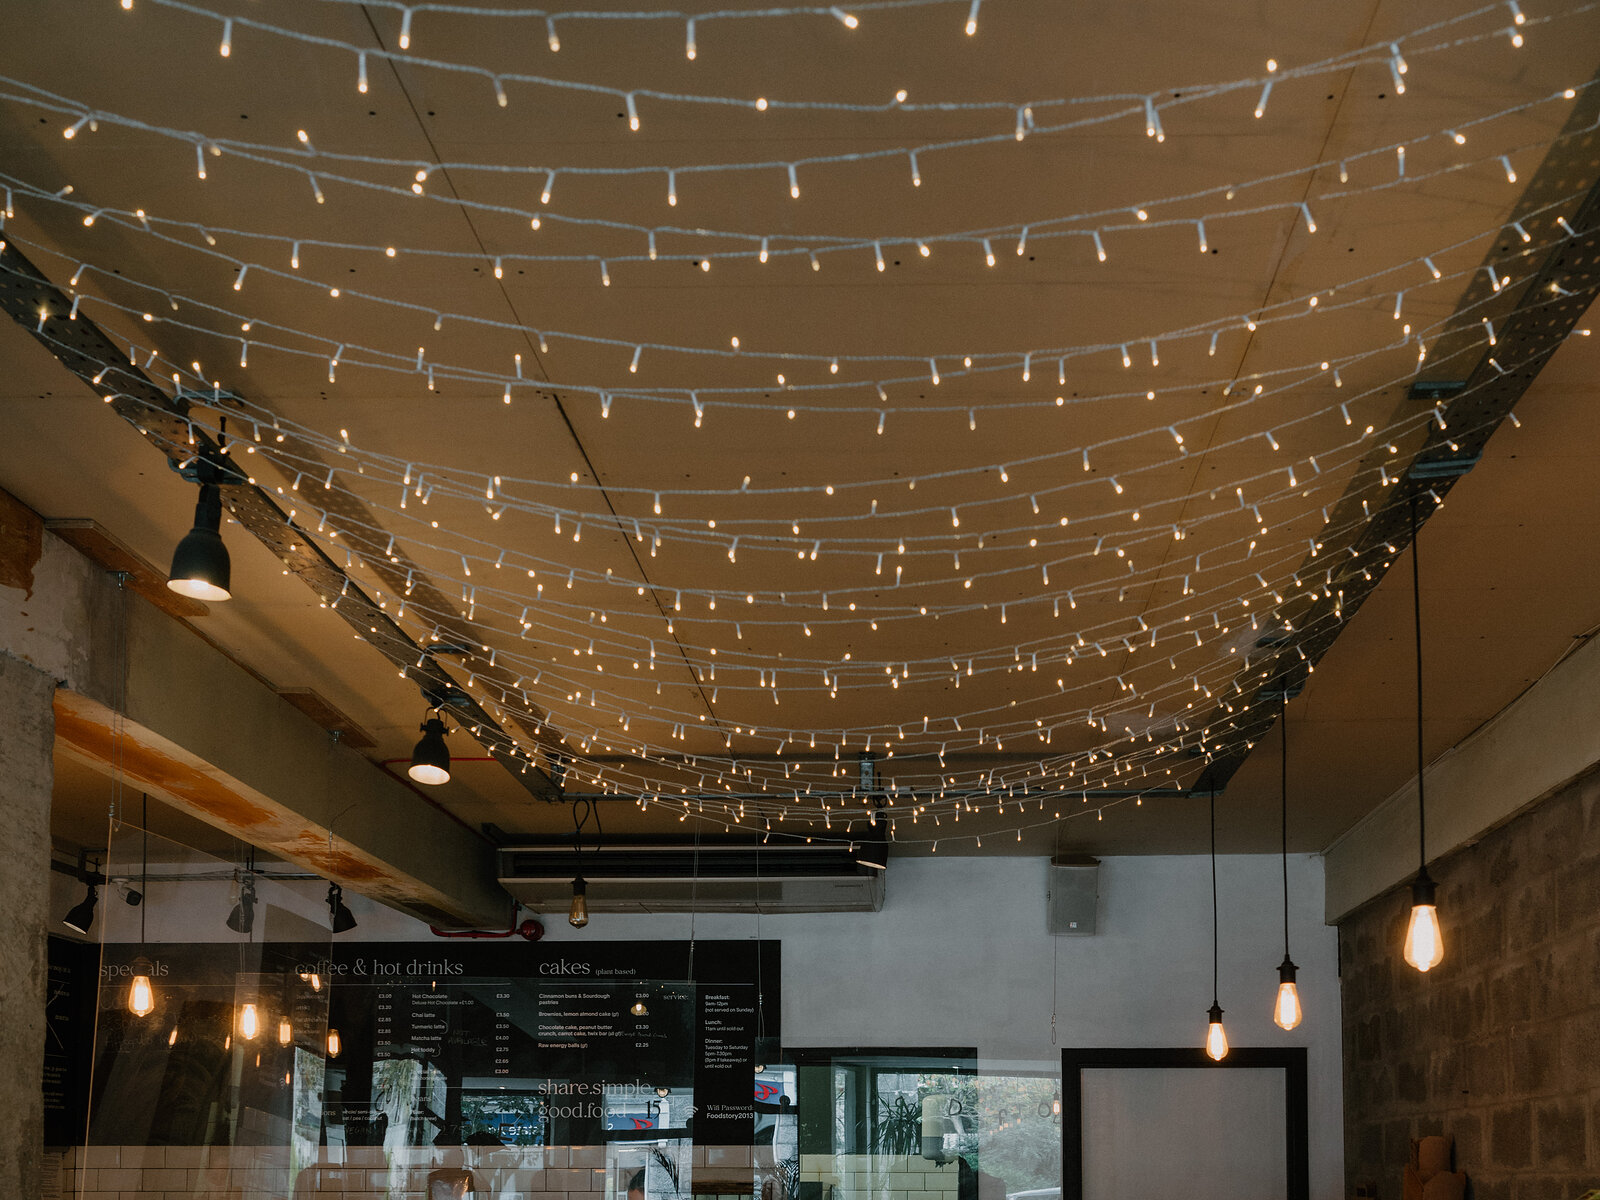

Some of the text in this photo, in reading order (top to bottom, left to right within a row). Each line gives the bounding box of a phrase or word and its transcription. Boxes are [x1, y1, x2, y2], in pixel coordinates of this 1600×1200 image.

[101, 961, 169, 981] specals
[295, 958, 463, 975] coffee & hot drinks
[539, 958, 591, 975] cakes
[646, 1100, 661, 1119] 15
[706, 1113, 754, 1121] Foodstory2013
